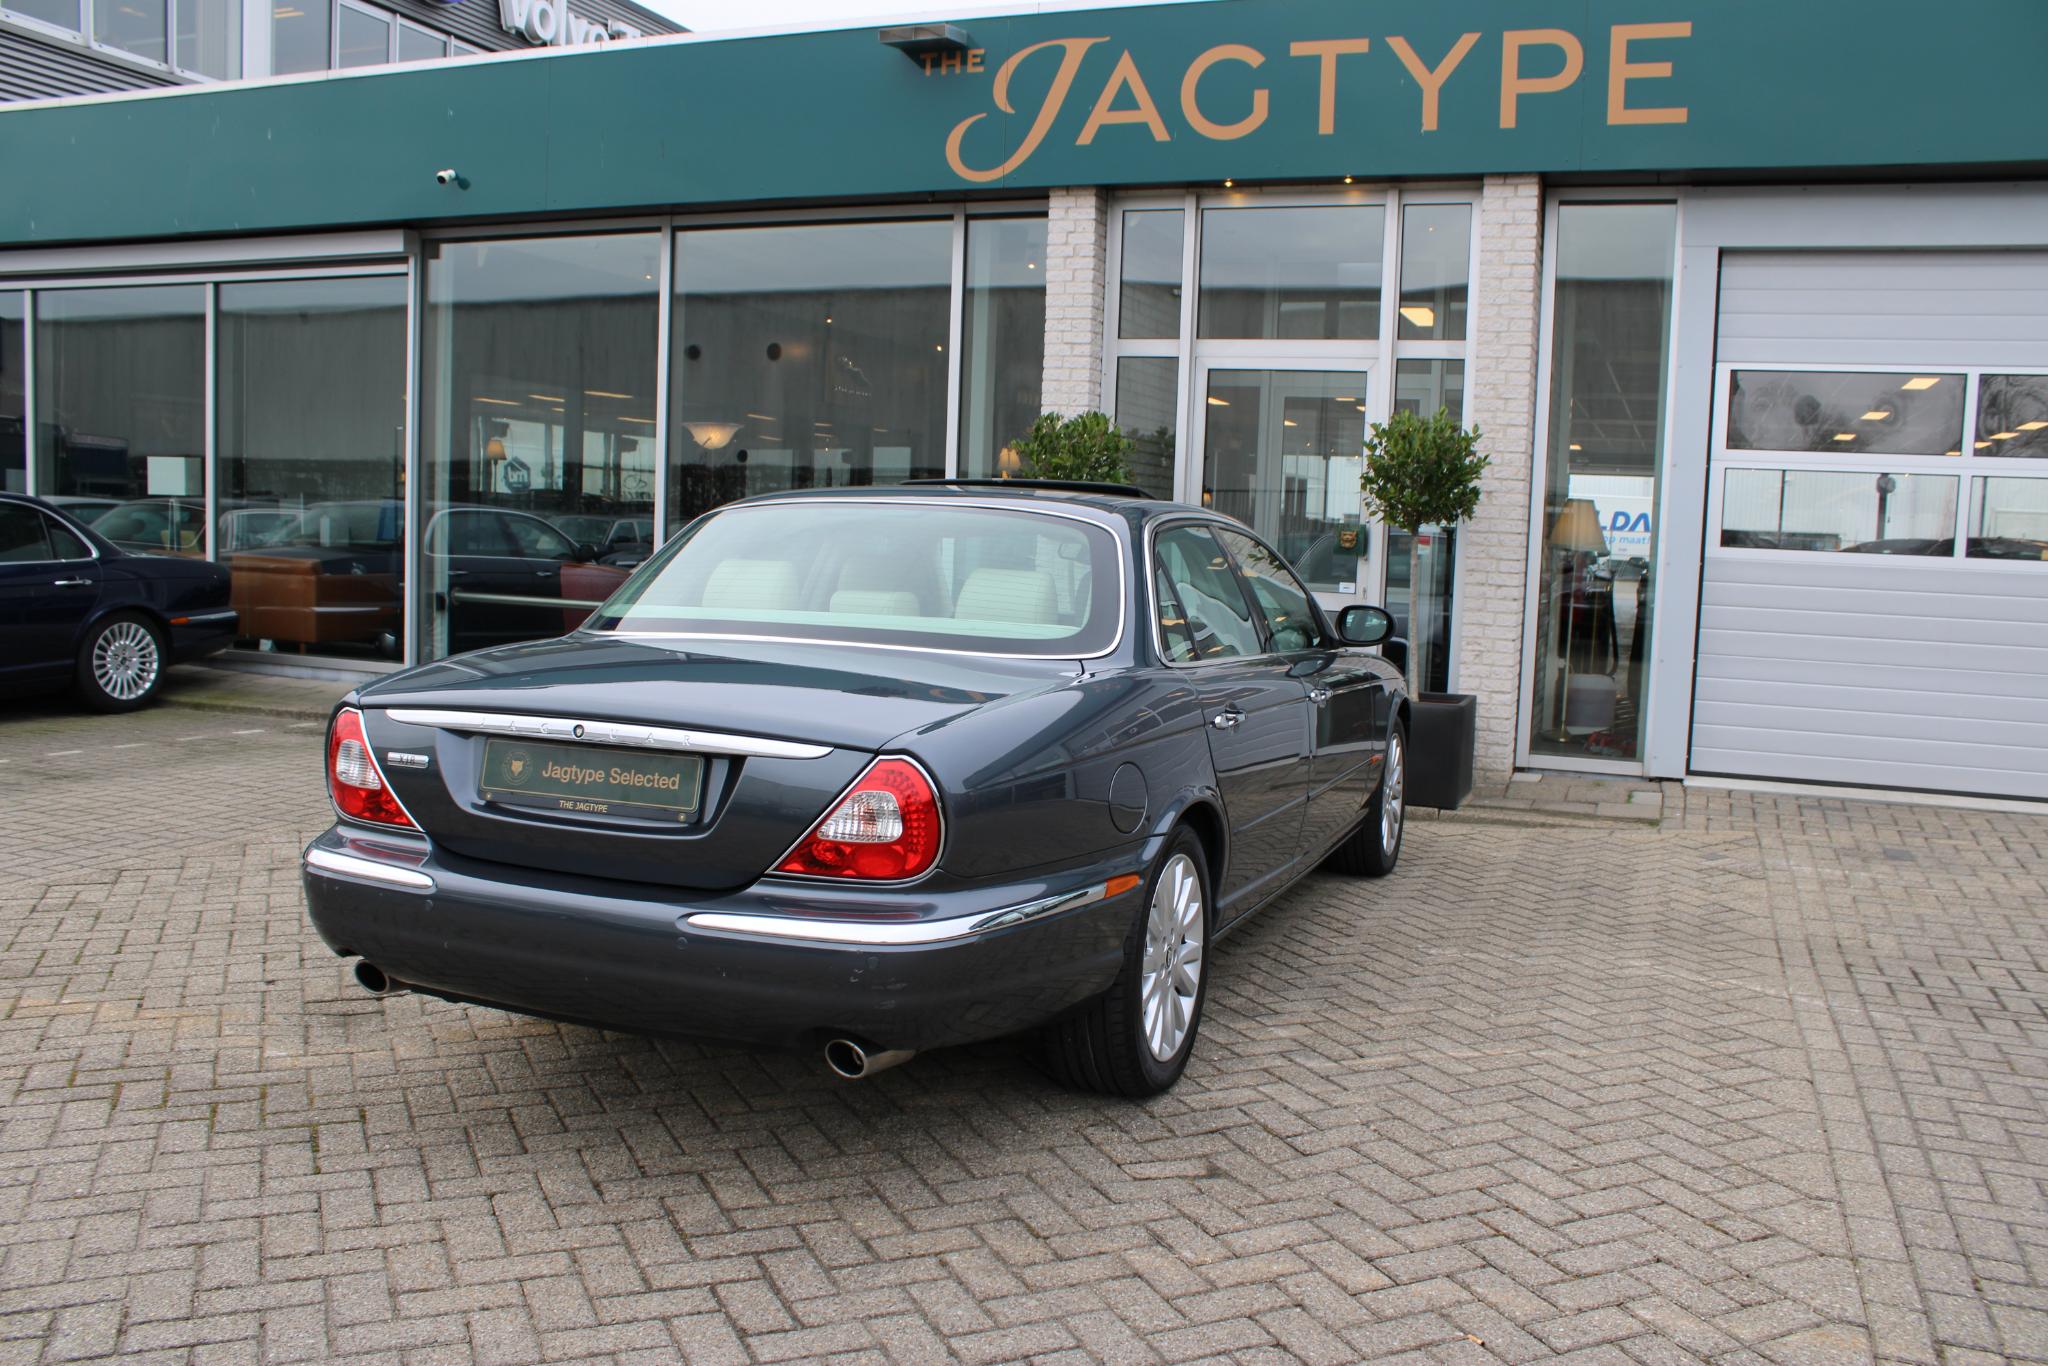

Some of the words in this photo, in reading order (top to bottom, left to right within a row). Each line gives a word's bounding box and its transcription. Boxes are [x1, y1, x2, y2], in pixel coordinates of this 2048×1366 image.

[919, 48, 985, 76] THE
[945, 21, 1692, 183] JAGTYPE
[480, 717, 691, 746] JAGUAR
[542, 761, 605, 785] Jagtype
[609, 767, 680, 790] Selected
[559, 800, 574, 809] THE
[575, 802, 608, 813] JAGTYPE
